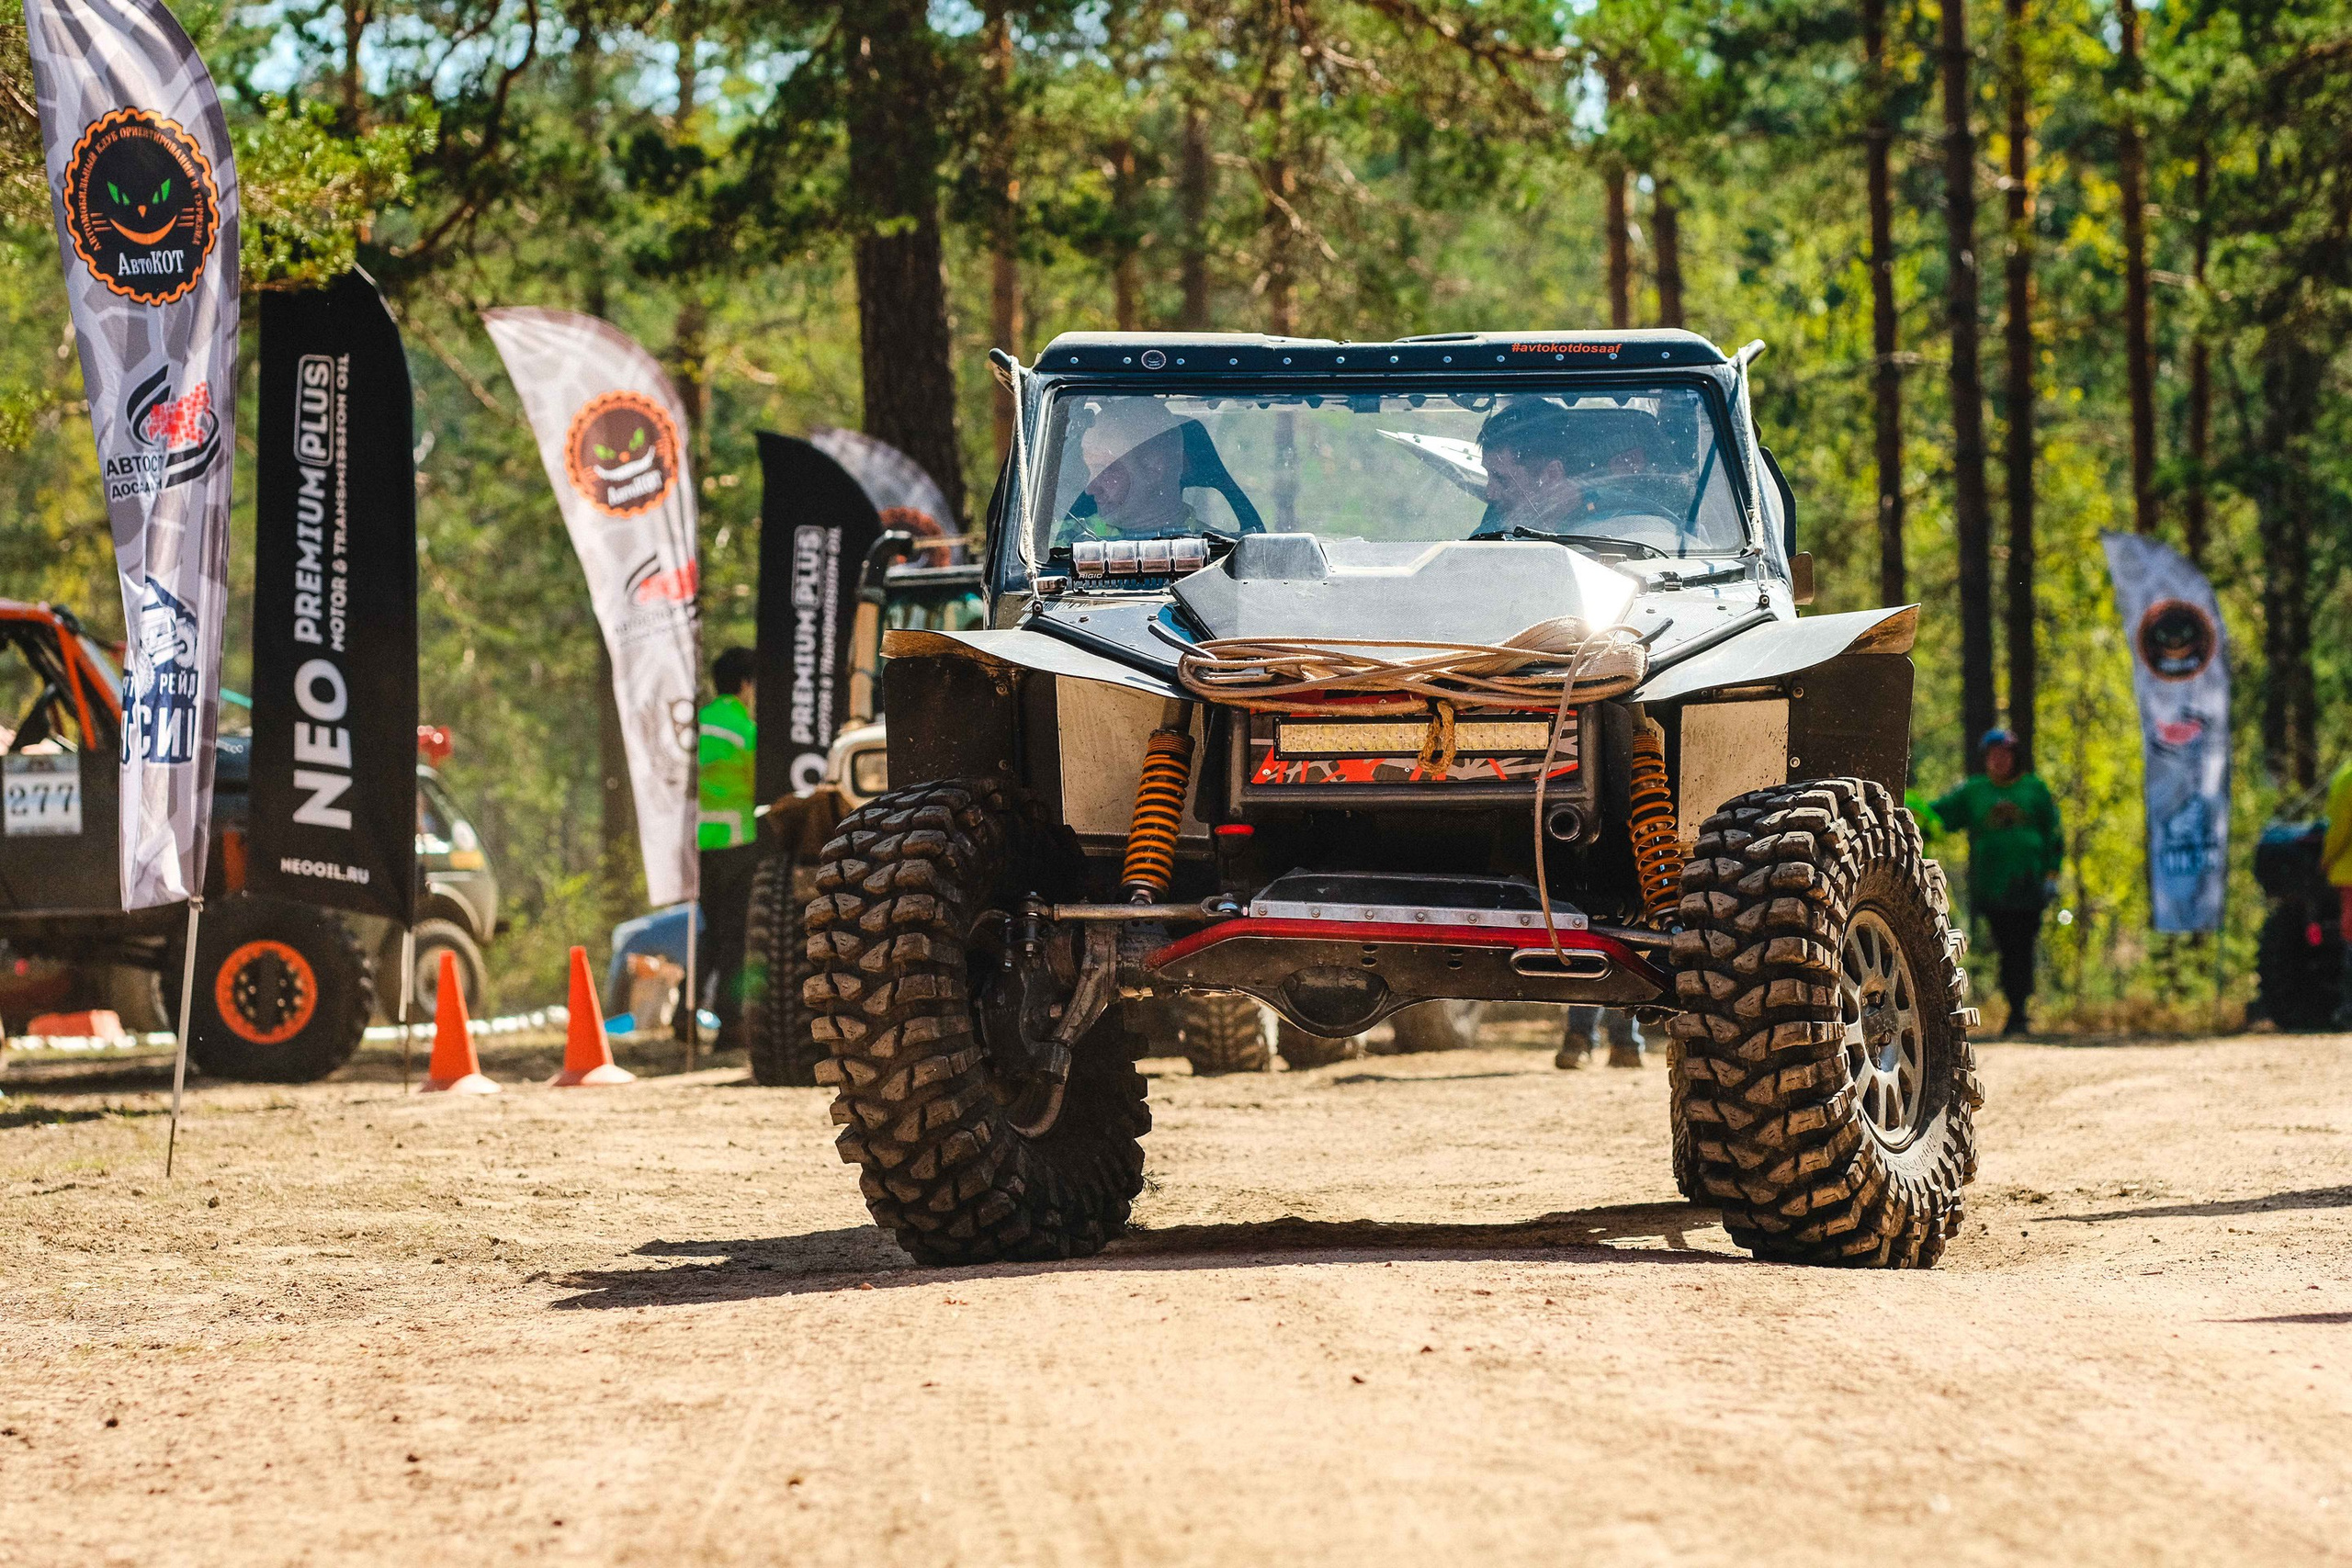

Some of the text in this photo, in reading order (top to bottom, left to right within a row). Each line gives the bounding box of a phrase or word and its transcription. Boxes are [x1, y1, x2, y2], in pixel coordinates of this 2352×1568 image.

[95, 130, 119, 154] КЛУБ
[1511, 343, 1623, 354] #avtokotdosaaf
[336, 353, 350, 390] OIL
[294, 362, 329, 644] PREMIUM PLUS
[796, 533, 821, 605] PLUS
[330, 576, 347, 652] MOTOR
[159, 670, 197, 699] РЕЙД
[791, 607, 817, 744] PREMIUM
[292, 659, 353, 830] NEO
[9, 784, 73, 815] 277
[280, 857, 369, 885] NEOOIL.RU
